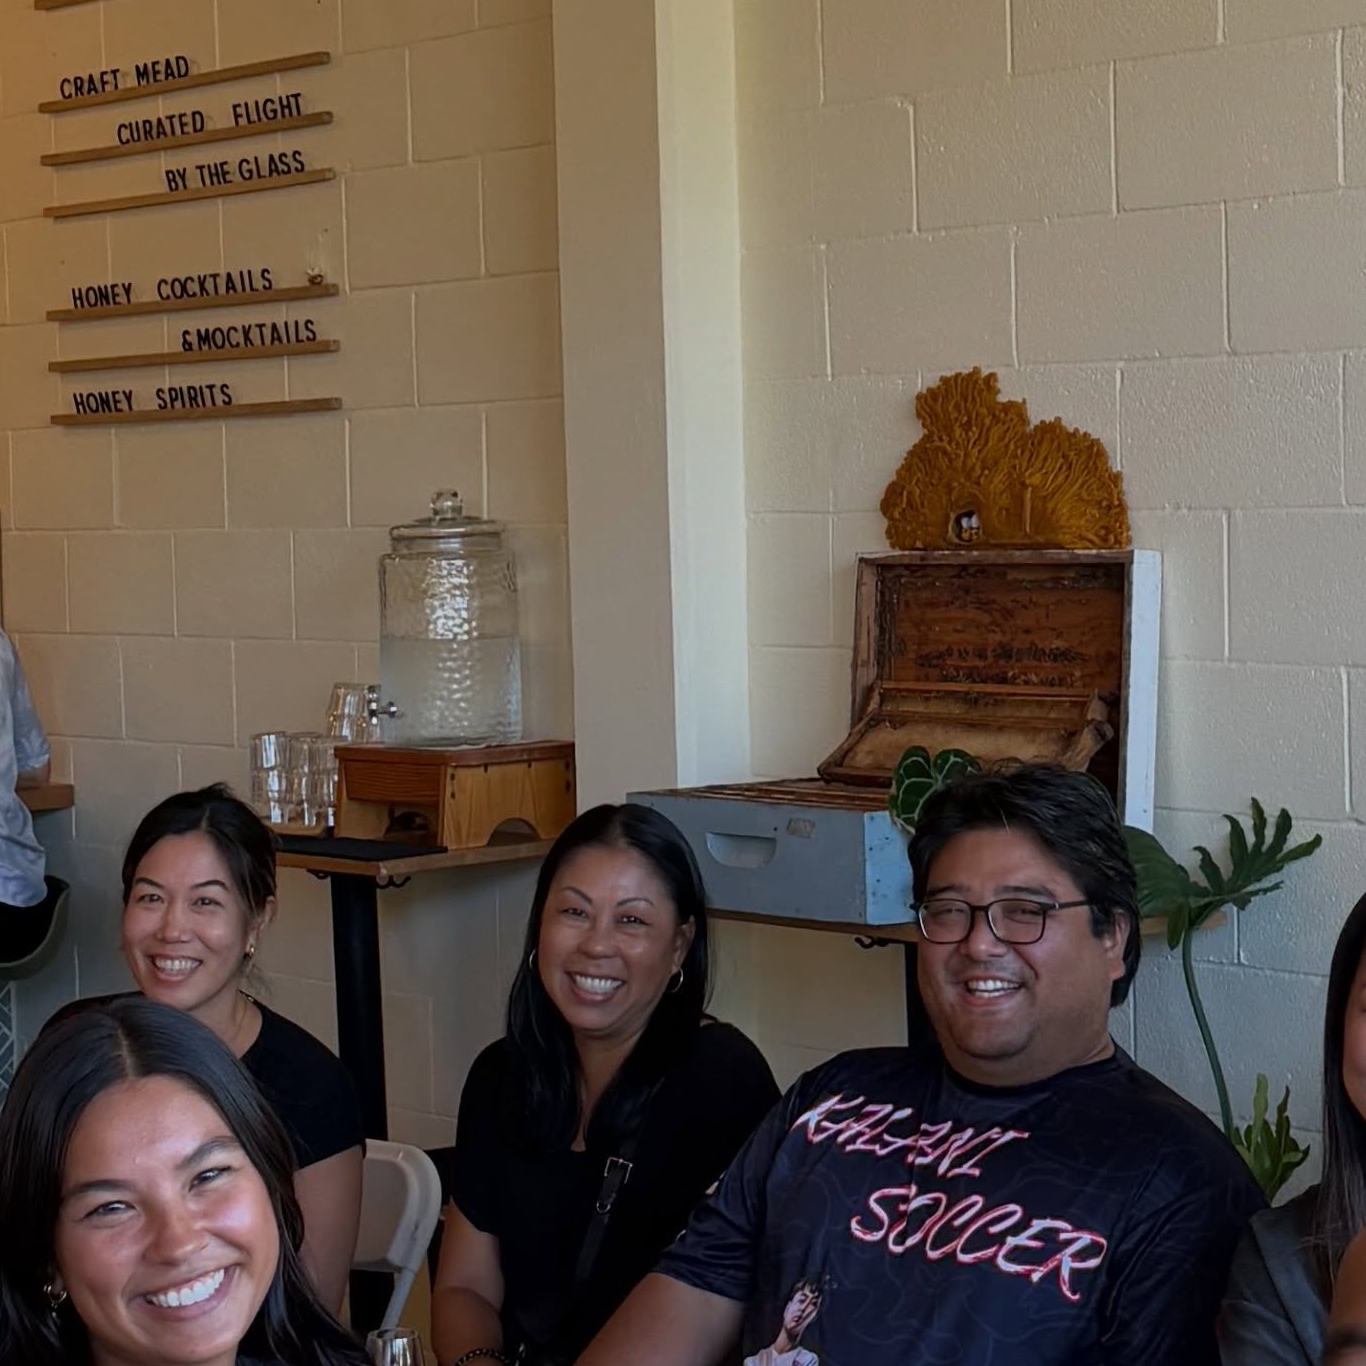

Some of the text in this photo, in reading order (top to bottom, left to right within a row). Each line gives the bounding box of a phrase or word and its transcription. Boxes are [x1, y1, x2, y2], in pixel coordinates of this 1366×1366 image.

[60, 55, 190, 100] CRAFT MEAD
[117, 92, 304, 146] CURATED FLIGHT
[164, 150, 306, 193] BY THE GLASS
[71, 268, 274, 310] HONEY COCKTAILS
[72, 383, 234, 416] HONEY SPIRITS
[791, 1092, 1031, 1179] KALANI
[850, 1184, 1108, 1303] SOCCER
